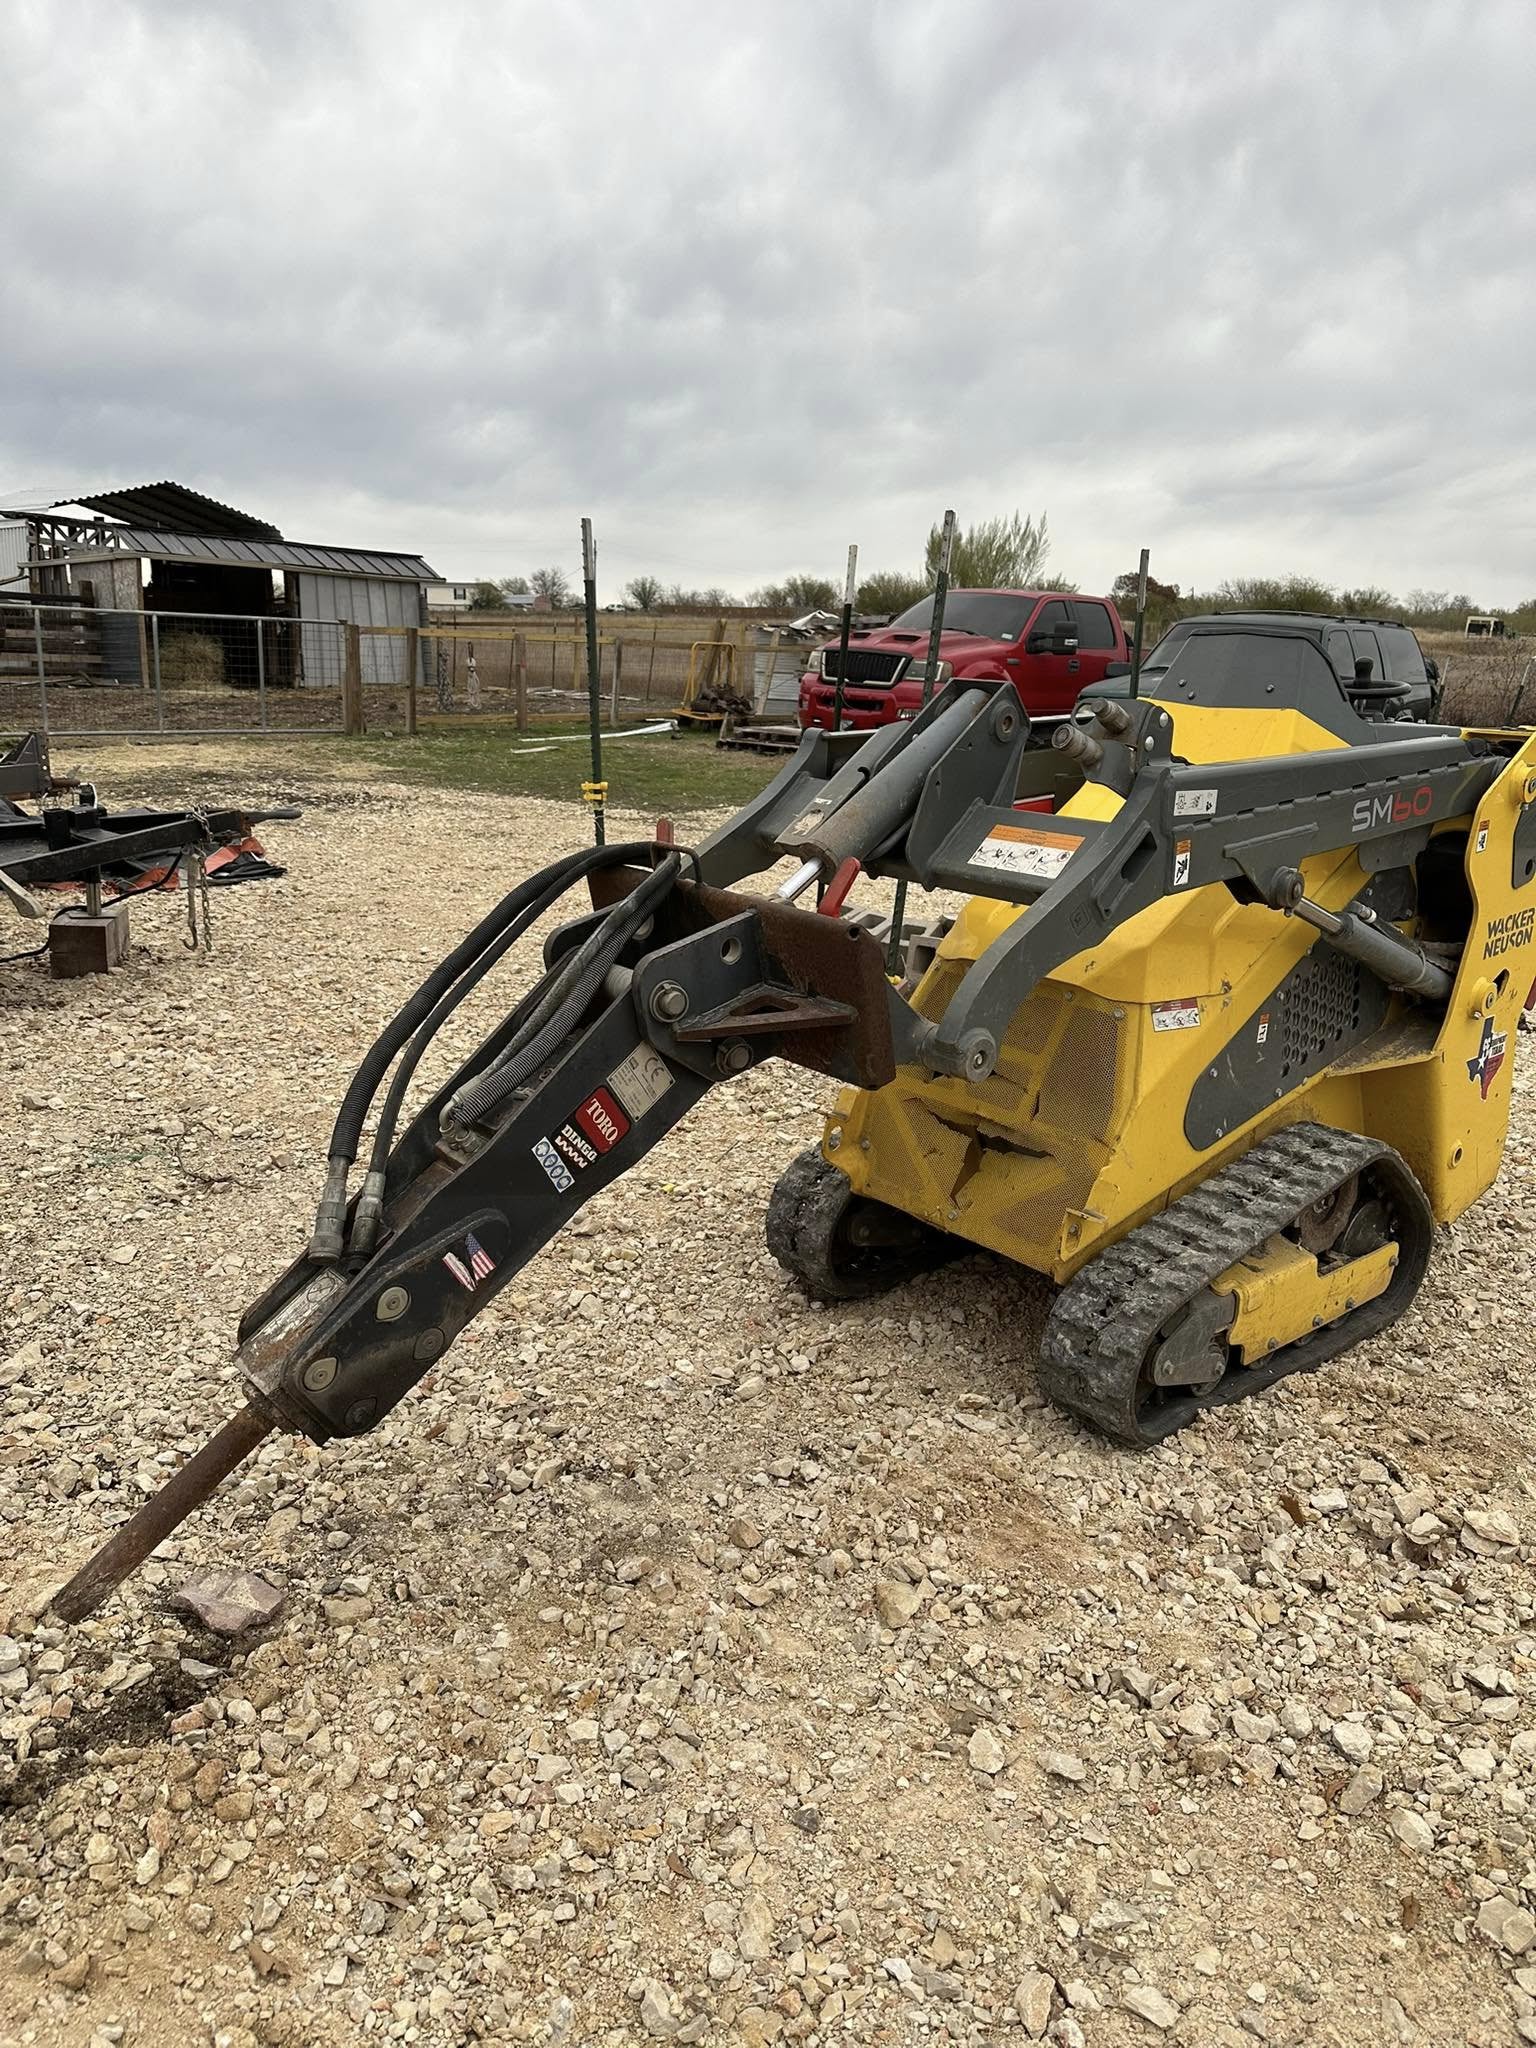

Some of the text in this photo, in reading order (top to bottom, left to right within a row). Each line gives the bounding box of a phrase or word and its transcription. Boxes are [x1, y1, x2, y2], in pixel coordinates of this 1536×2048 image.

[1352, 787, 1433, 832] SM60
[1488, 908, 1535, 939] WACKER
[1483, 926, 1533, 960] NEUSON
[645, 1057, 664, 1083] CE
[586, 1098, 619, 1142] TORO
[561, 1124, 598, 1161] DINGO
